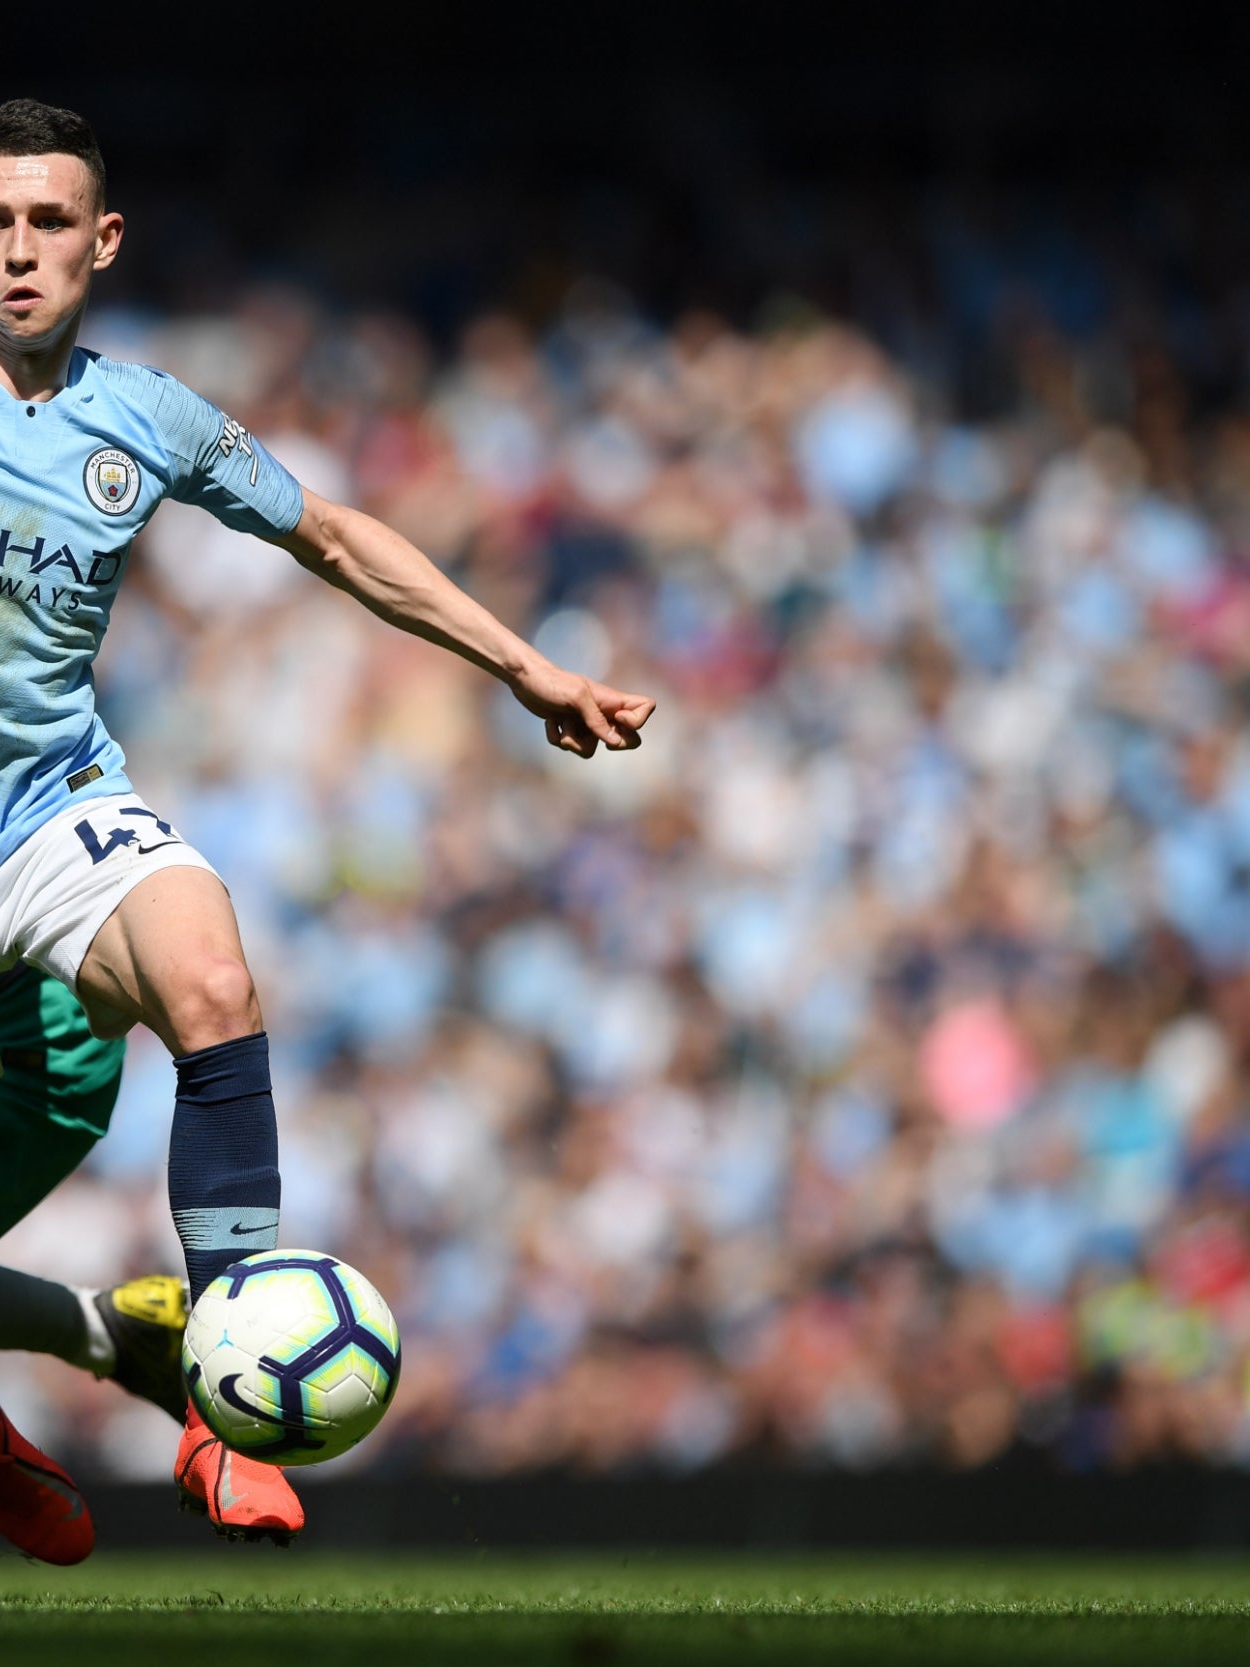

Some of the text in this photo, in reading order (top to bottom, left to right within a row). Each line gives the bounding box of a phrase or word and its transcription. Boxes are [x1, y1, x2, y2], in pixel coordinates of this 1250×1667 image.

[90, 451, 136, 474] MANCHESTER
[104, 503, 121, 511] CITY
[73, 807, 172, 866] 47
